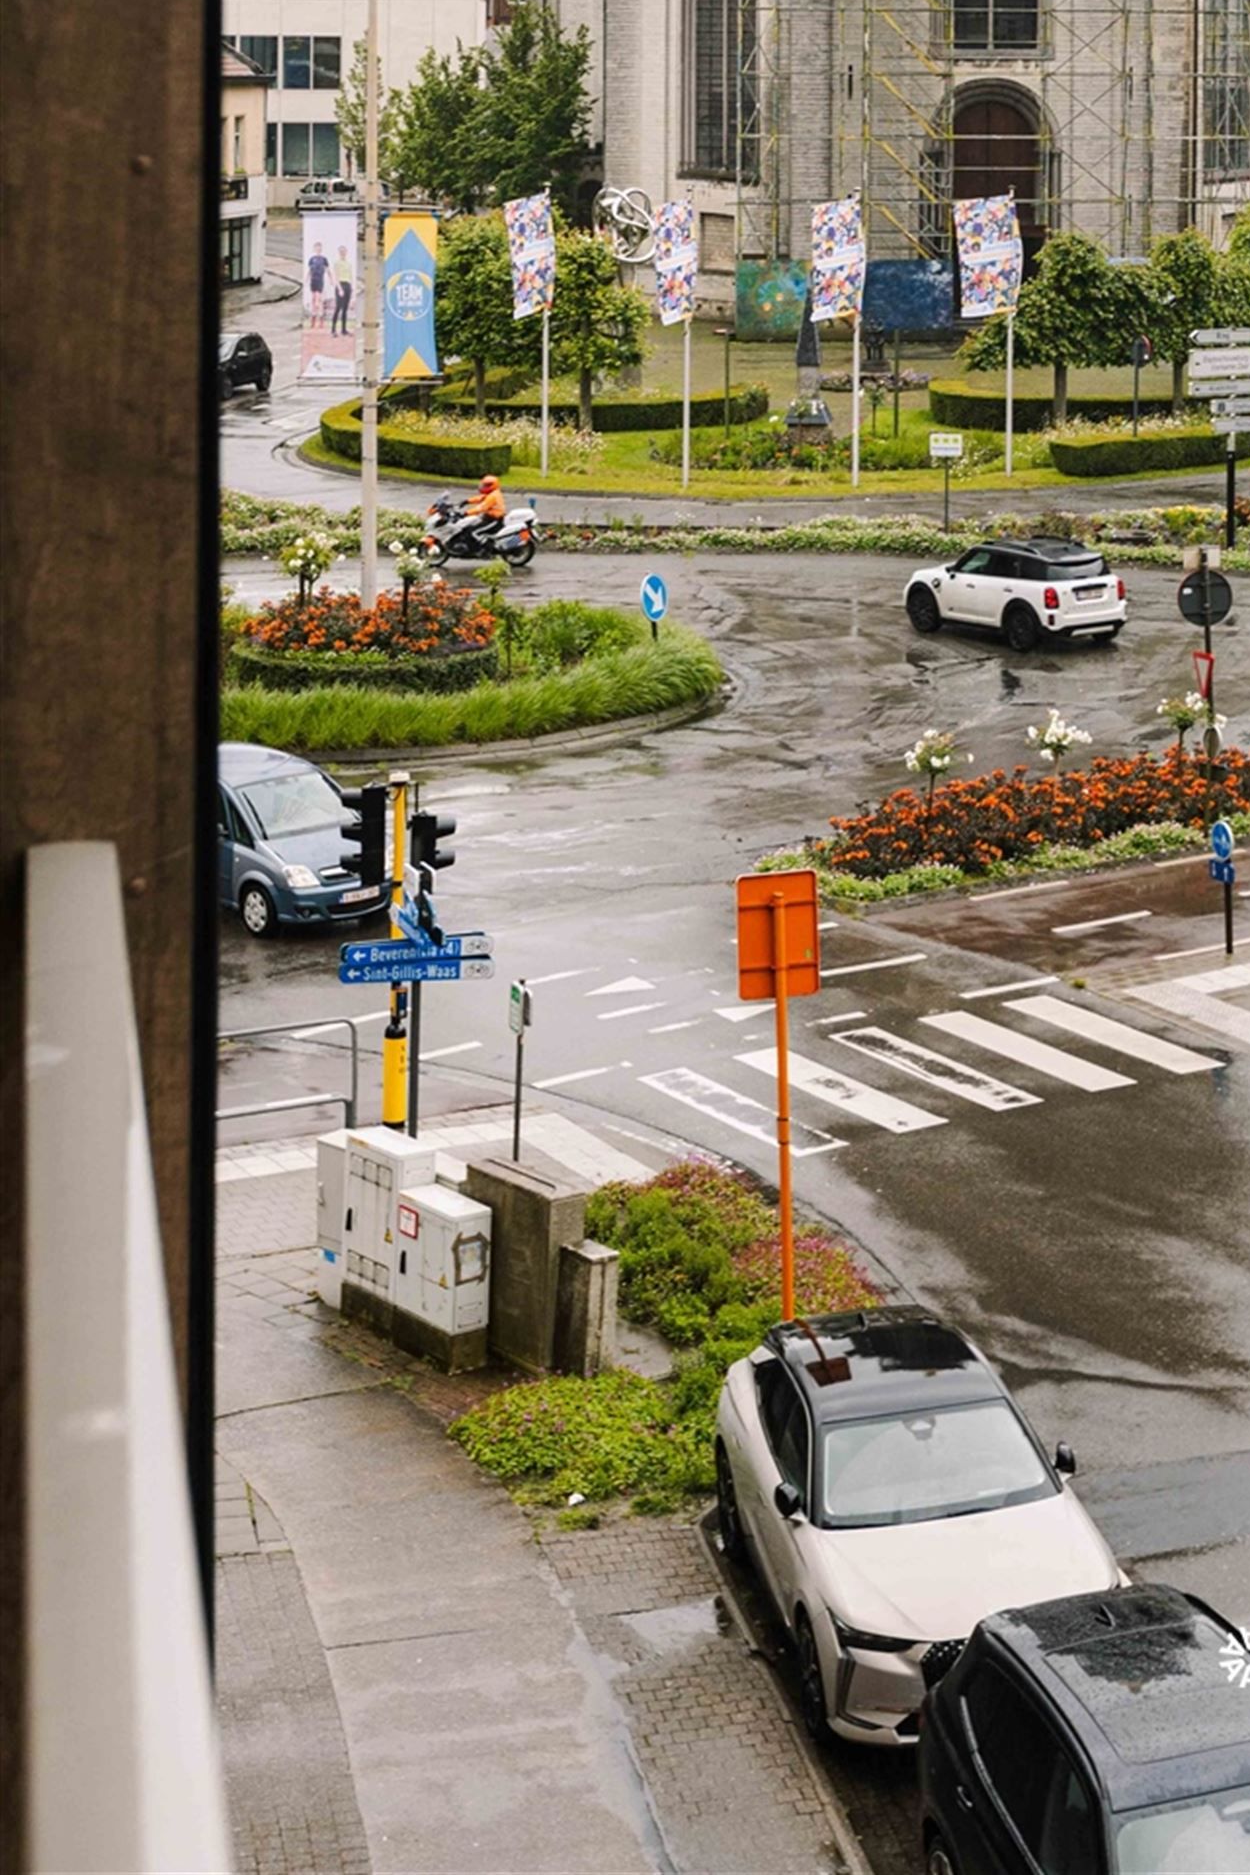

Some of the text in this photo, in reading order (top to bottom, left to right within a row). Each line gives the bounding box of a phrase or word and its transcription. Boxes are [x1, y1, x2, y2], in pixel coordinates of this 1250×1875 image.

[396, 283, 423, 301] TEAM
[370, 947, 417, 963] Beveren
[363, 965, 457, 982] Sint-Gillis-Waas
